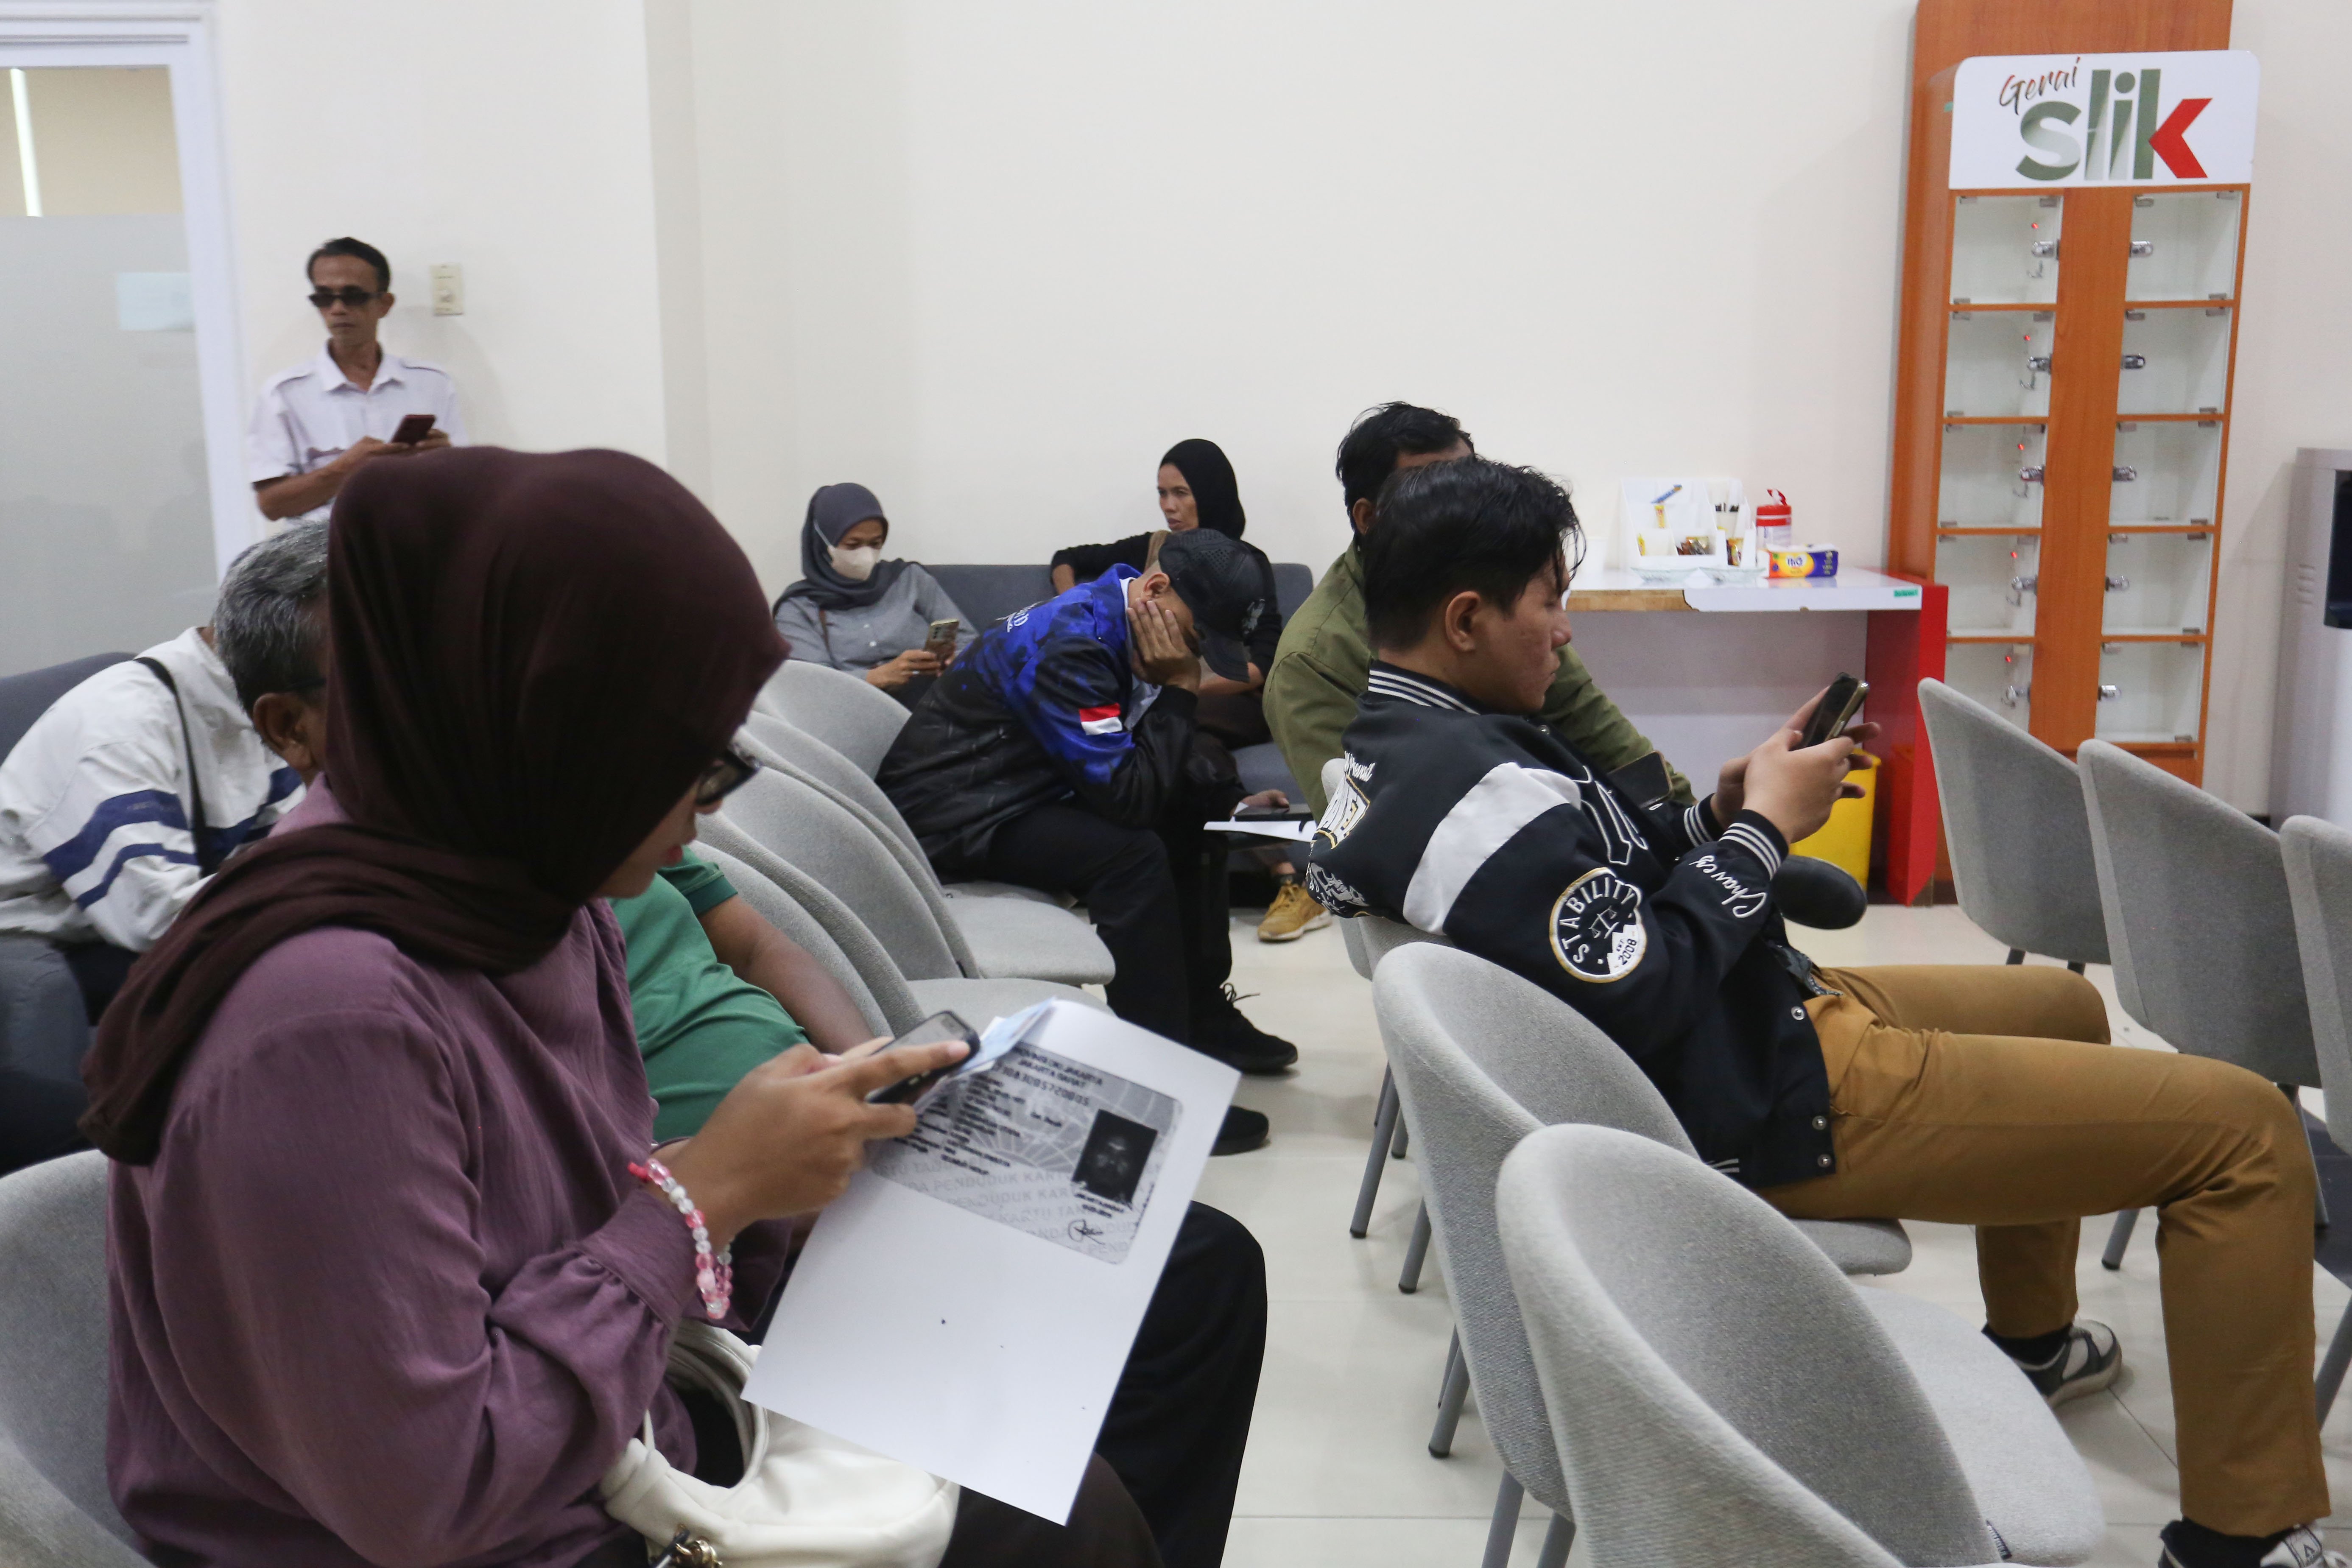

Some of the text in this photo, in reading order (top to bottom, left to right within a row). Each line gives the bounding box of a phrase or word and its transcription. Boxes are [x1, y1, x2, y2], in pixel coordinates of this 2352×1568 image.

[1999, 56, 2080, 115] Gerai
[1559, 876, 1635, 964] STABILITY
[1618, 938, 1637, 966] 2008
